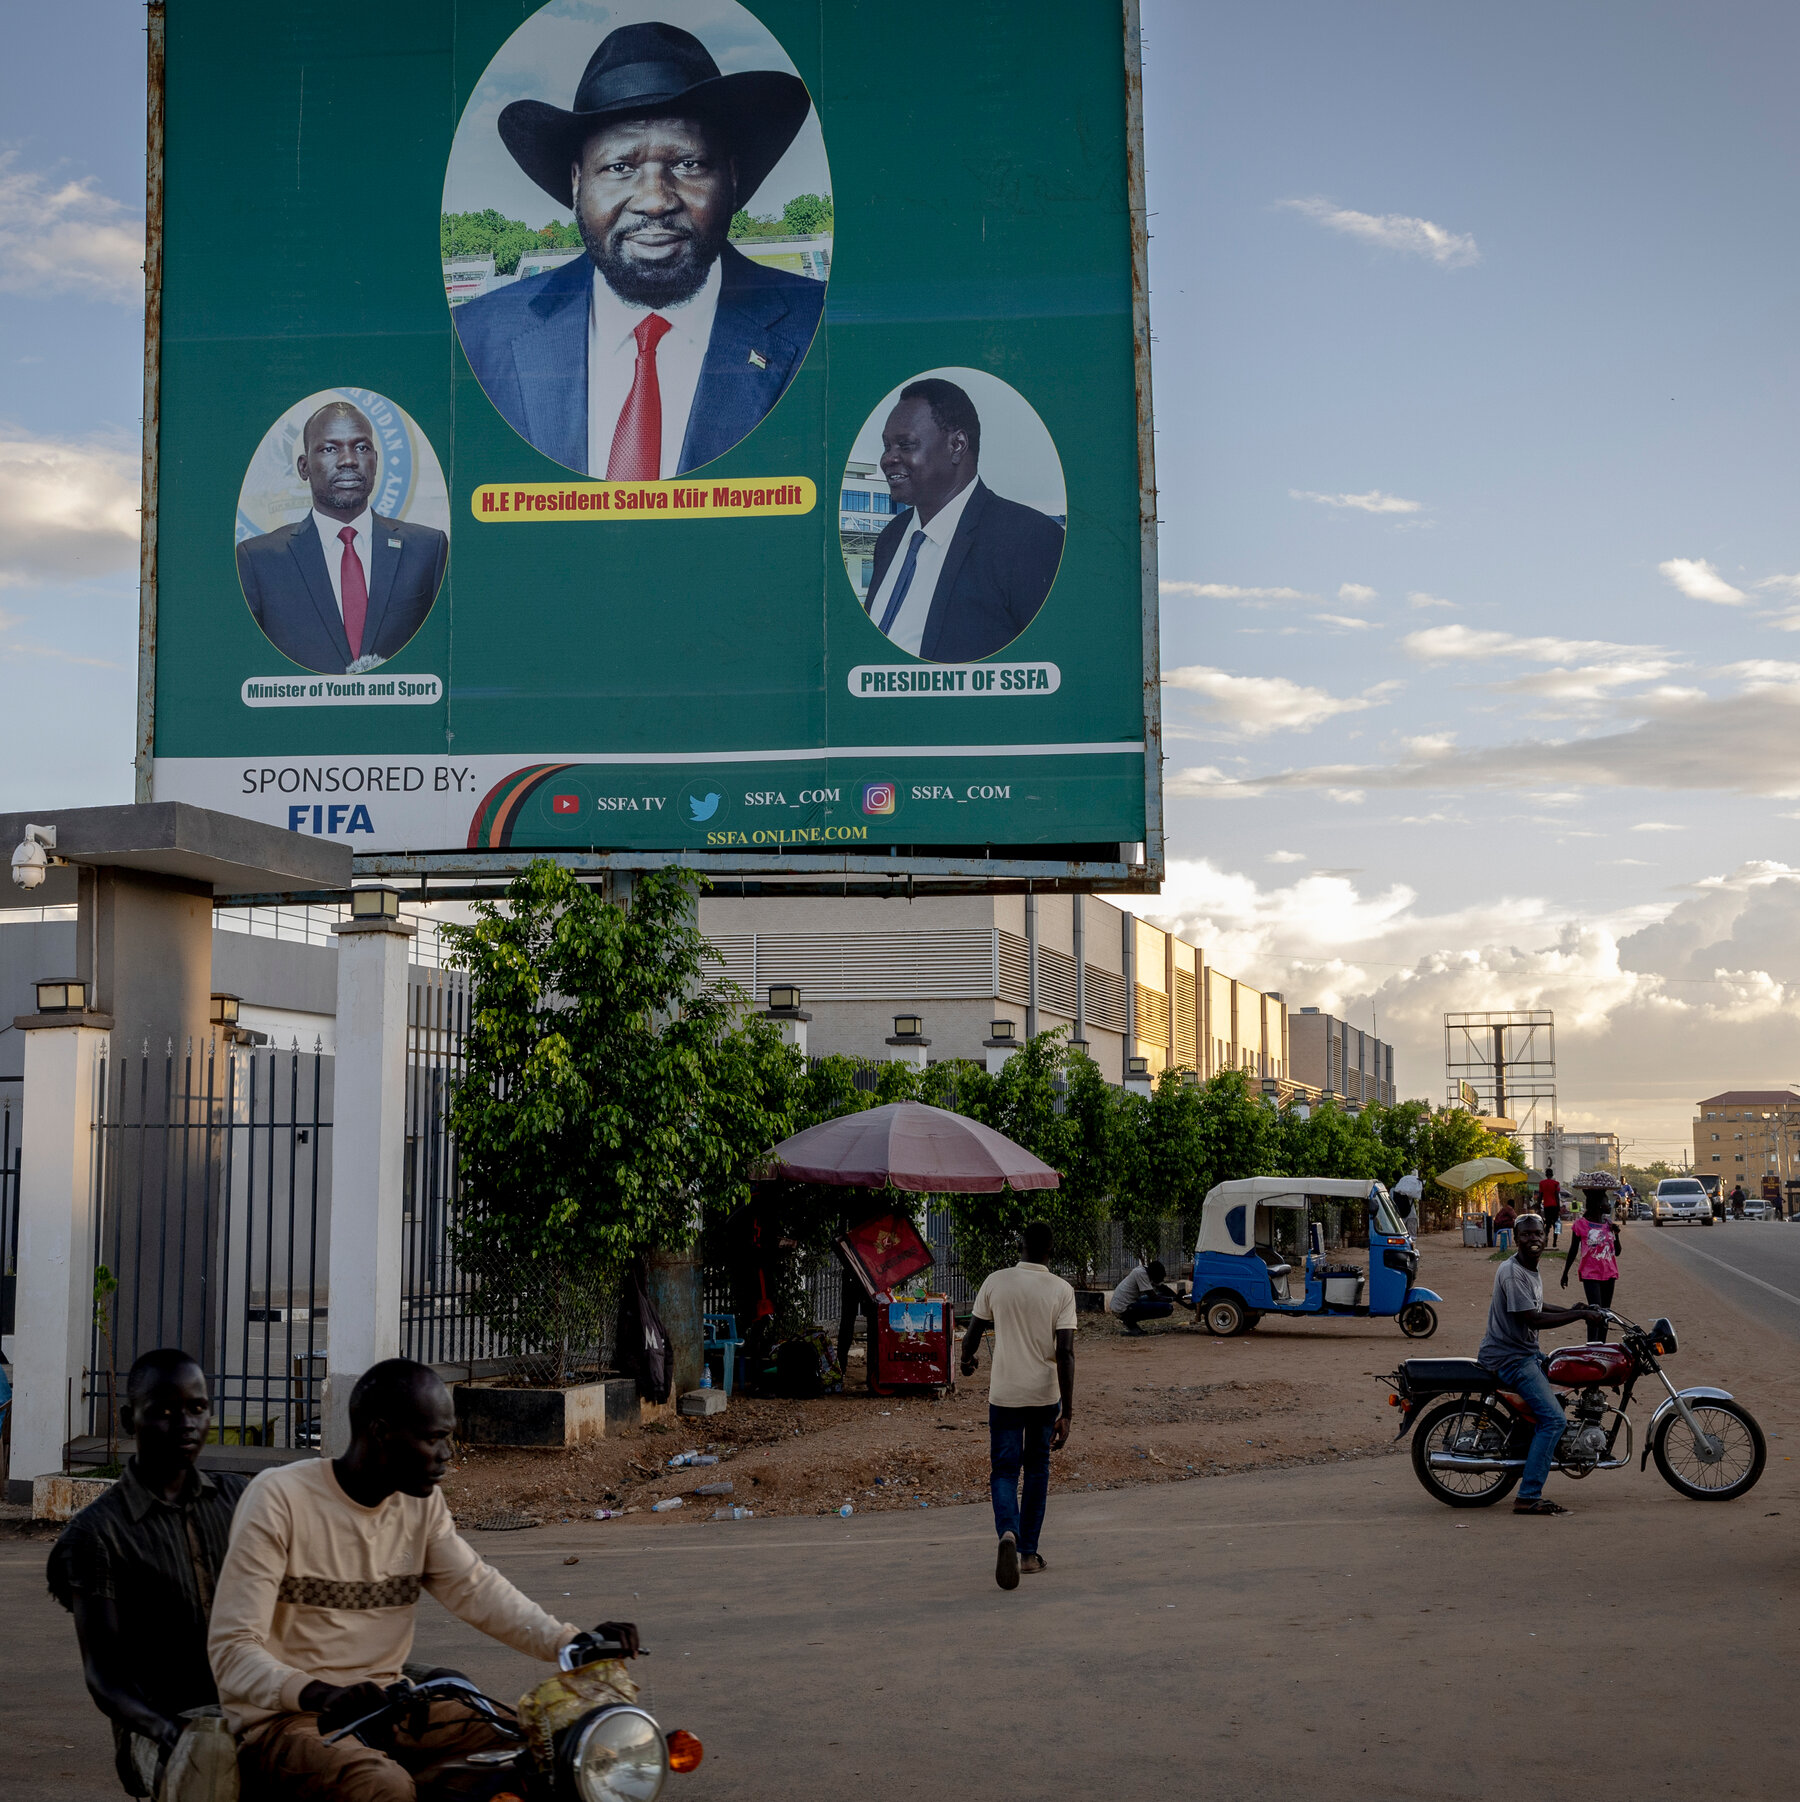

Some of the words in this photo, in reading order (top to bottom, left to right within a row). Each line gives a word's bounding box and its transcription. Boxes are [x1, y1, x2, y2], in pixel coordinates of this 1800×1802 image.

[482, 491, 510, 512] H.E
[514, 490, 610, 512] President
[614, 489, 669, 510] Salva
[673, 488, 709, 510] Kiir
[713, 485, 802, 510] Mayardit
[247, 683, 306, 699] Minister
[309, 682, 323, 697] of
[326, 681, 365, 697] Youth
[368, 681, 395, 696] and
[398, 680, 437, 697] Sport
[861, 670, 967, 692] PRESIDENT
[972, 669, 996, 691] OF
[1000, 668, 1049, 690] SSFA
[242, 766, 424, 794] SPONSORED
[434, 766, 476, 793] BY:
[597, 796, 639, 811] SSFA
[642, 796, 667, 811] TV
[288, 804, 376, 835] FIFA
[752, 825, 869, 844] ONLINE.COM
